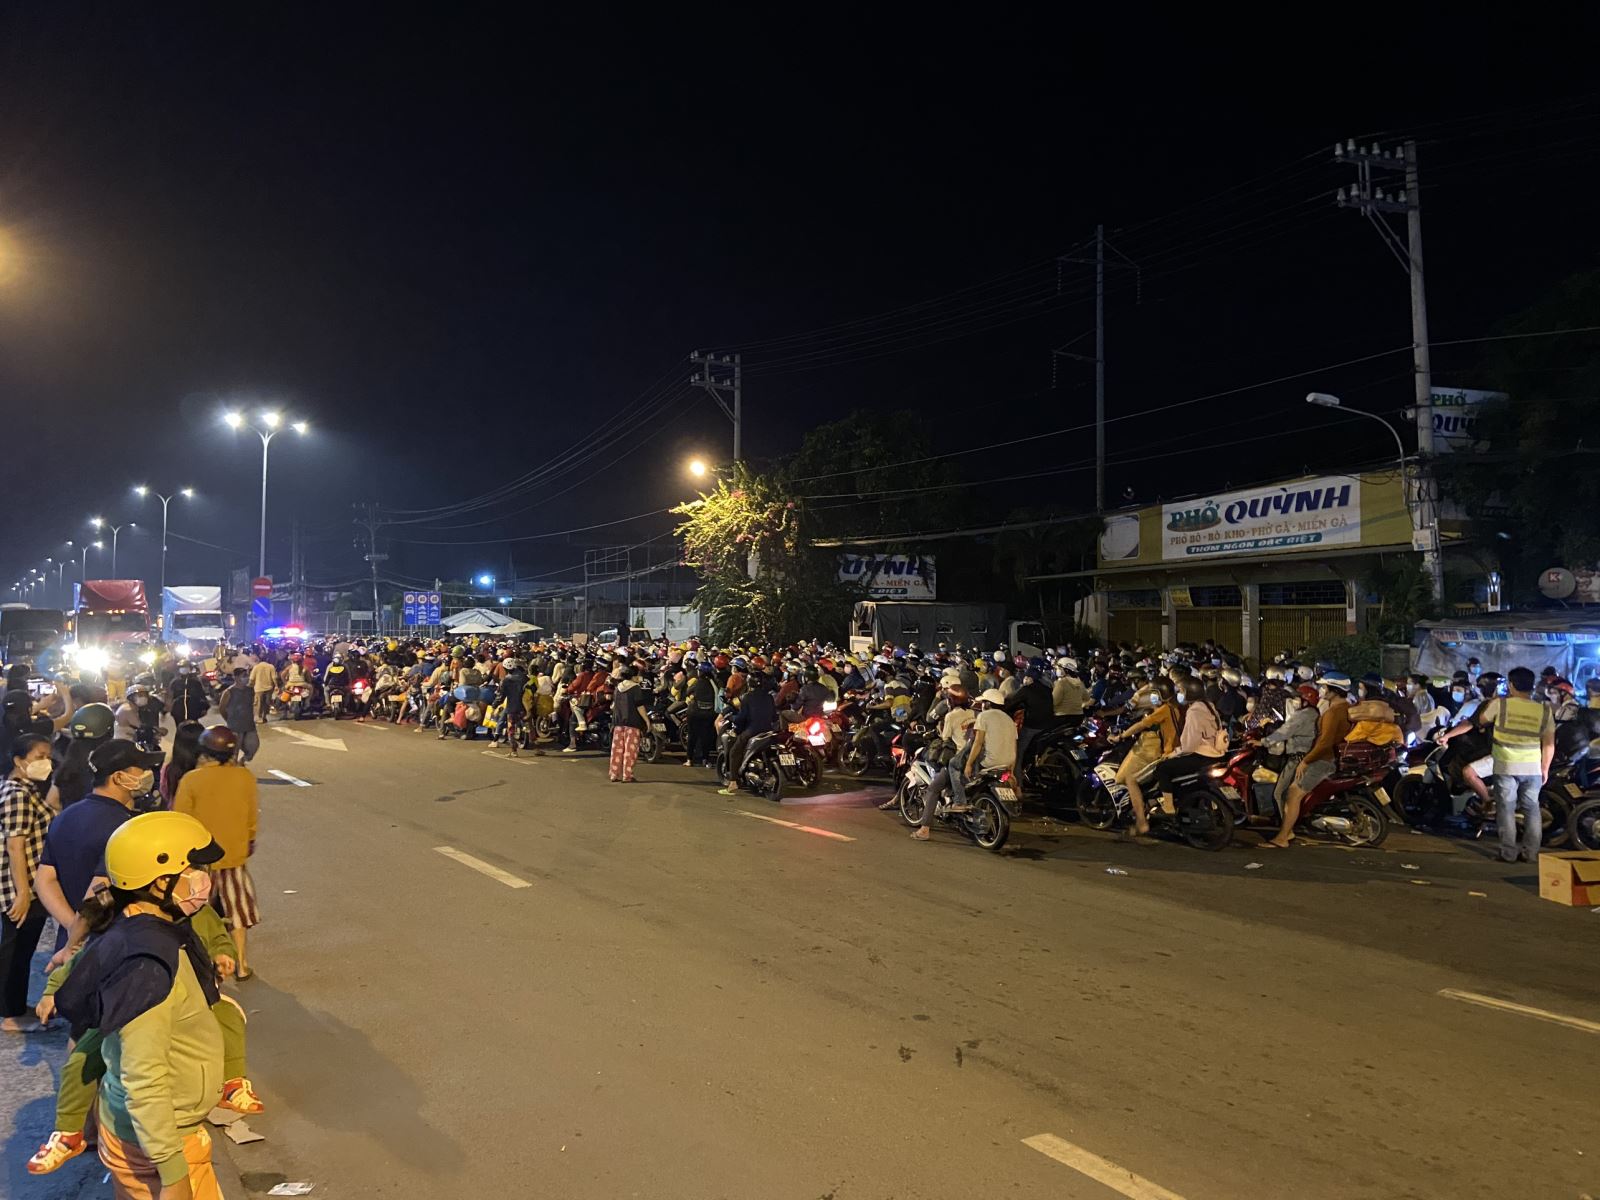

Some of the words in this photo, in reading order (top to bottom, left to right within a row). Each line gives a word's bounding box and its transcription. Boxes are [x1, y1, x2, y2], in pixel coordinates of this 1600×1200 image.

[1171, 500, 1221, 528] PHỞ
[1225, 485, 1351, 524] QUỲNH
[1224, 529, 1246, 539] KHO
[1223, 541, 1255, 550] NGON
